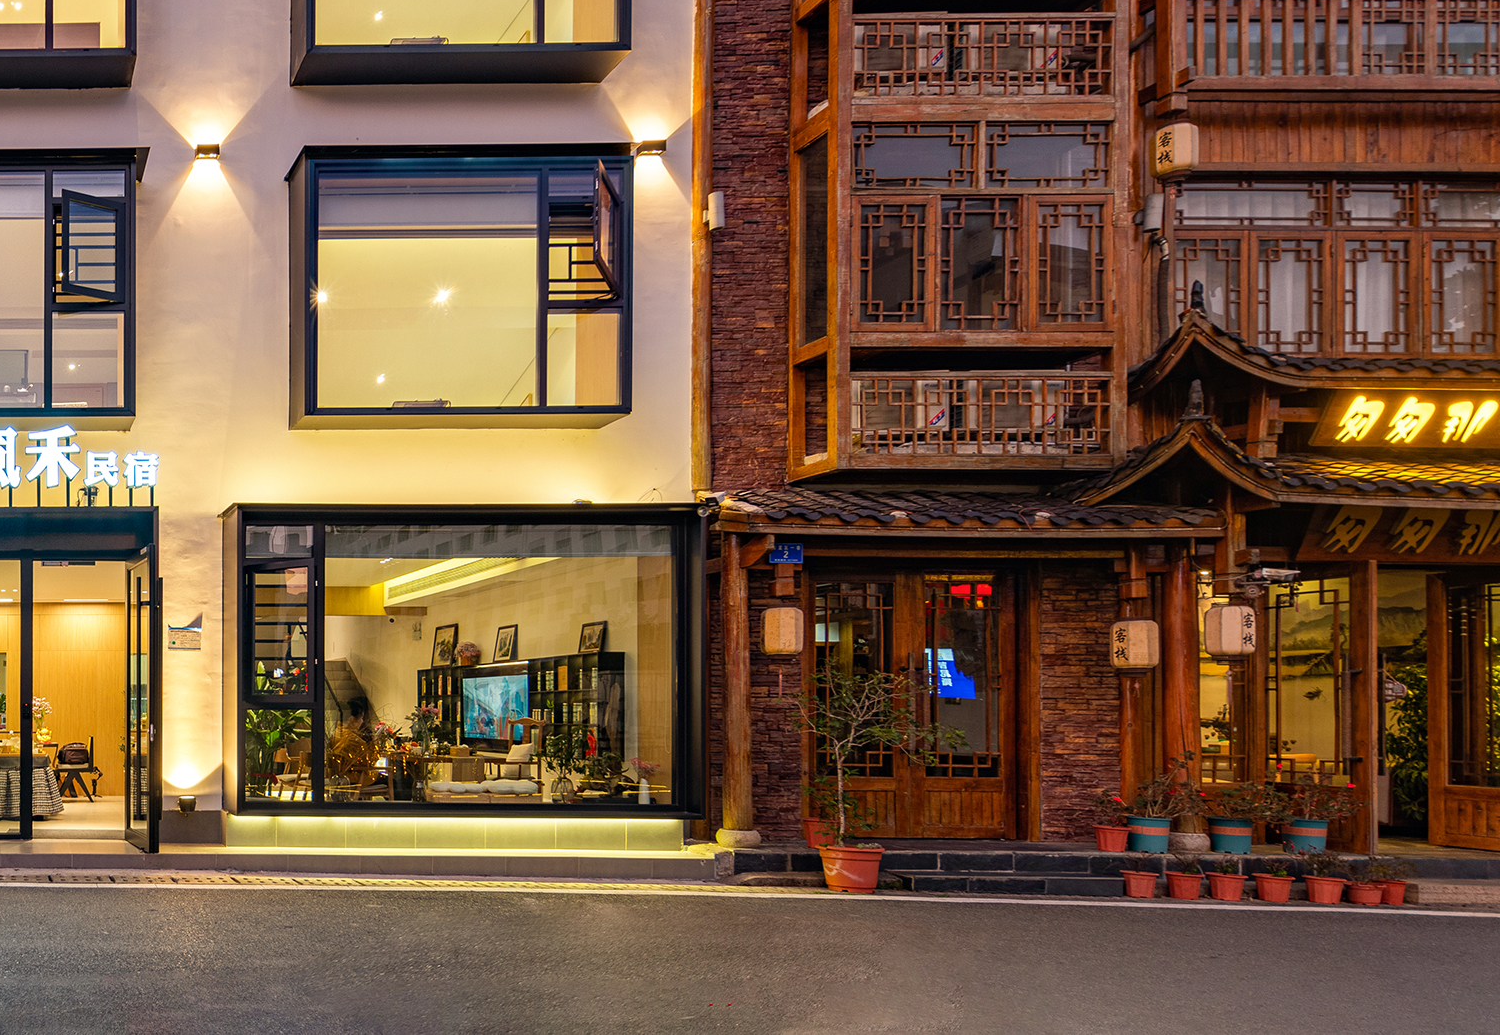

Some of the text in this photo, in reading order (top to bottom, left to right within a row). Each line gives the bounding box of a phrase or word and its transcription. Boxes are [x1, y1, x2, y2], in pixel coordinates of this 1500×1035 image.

[1157, 131, 1173, 165] 客栈
[783, 550, 789, 559] 2
[1114, 627, 1129, 662] 客栈
[1242, 612, 1256, 648] 客栈
